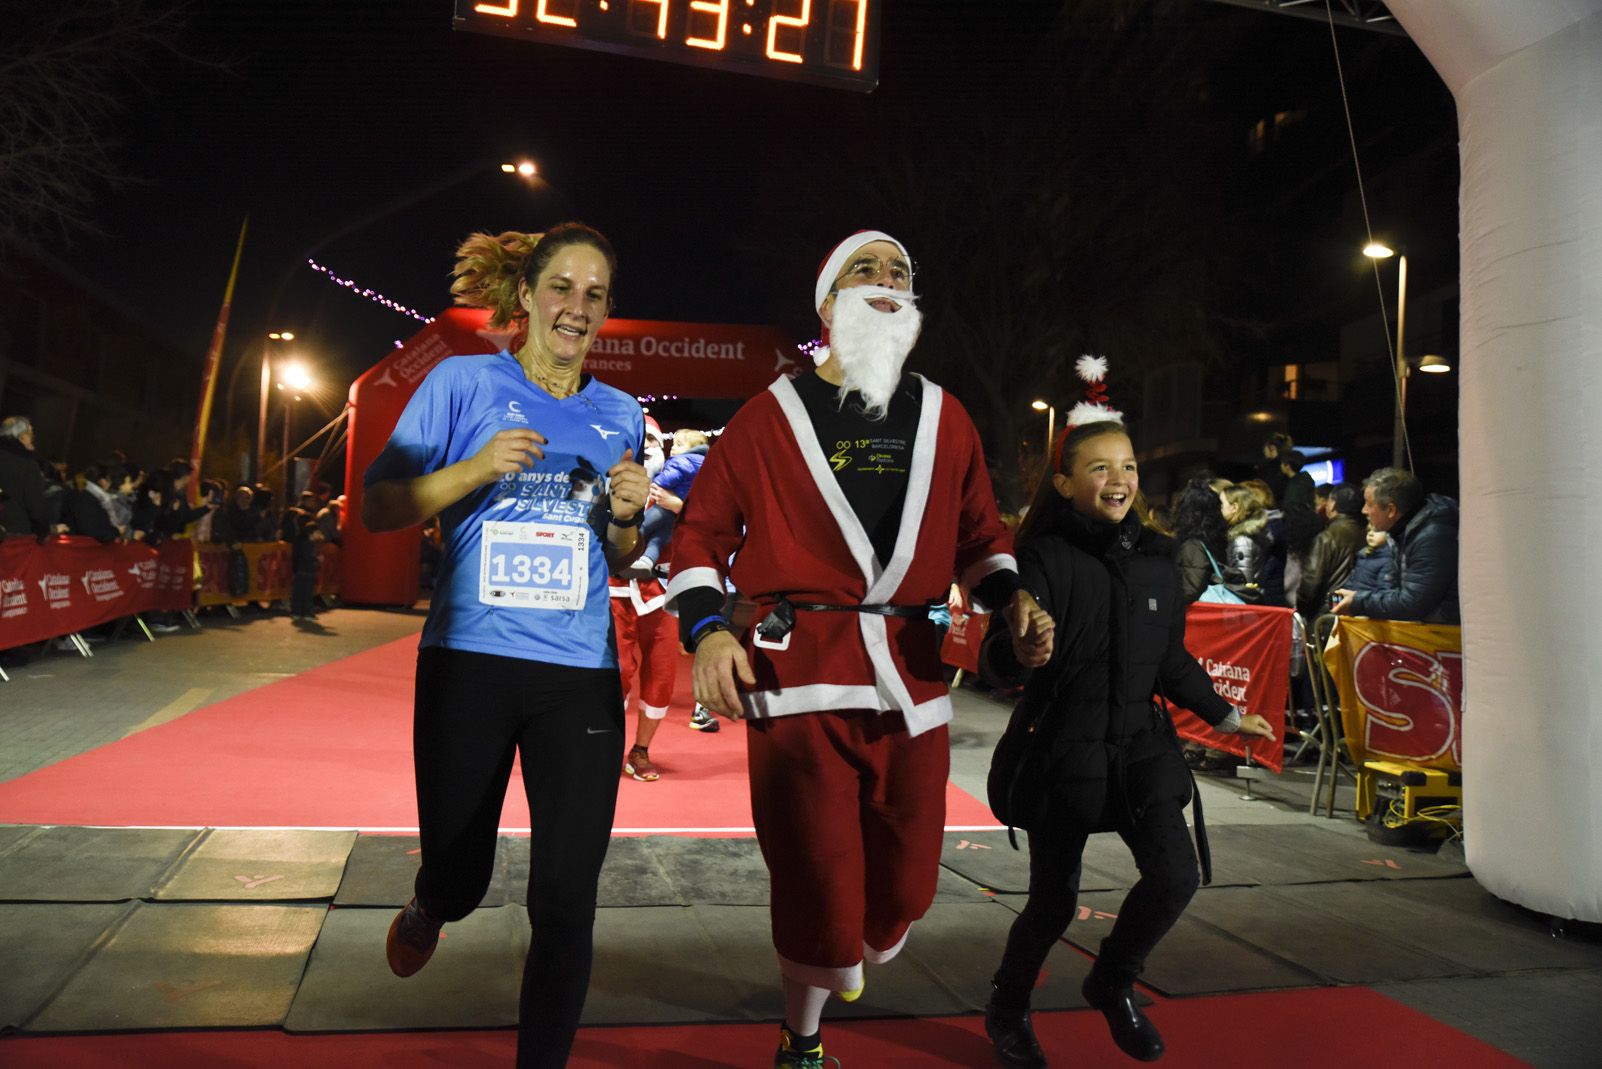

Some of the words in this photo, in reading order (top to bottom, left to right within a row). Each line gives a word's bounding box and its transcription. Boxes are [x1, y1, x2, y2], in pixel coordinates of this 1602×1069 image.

[640, 336, 745, 360] Occident
[519, 472, 552, 483] anys
[520, 481, 573, 499] SANT
[515, 497, 591, 517] SILVEST
[542, 513, 562, 521] Sant
[577, 532, 585, 551] 1334
[490, 554, 571, 587] 1334
[1213, 679, 1248, 702] cident
